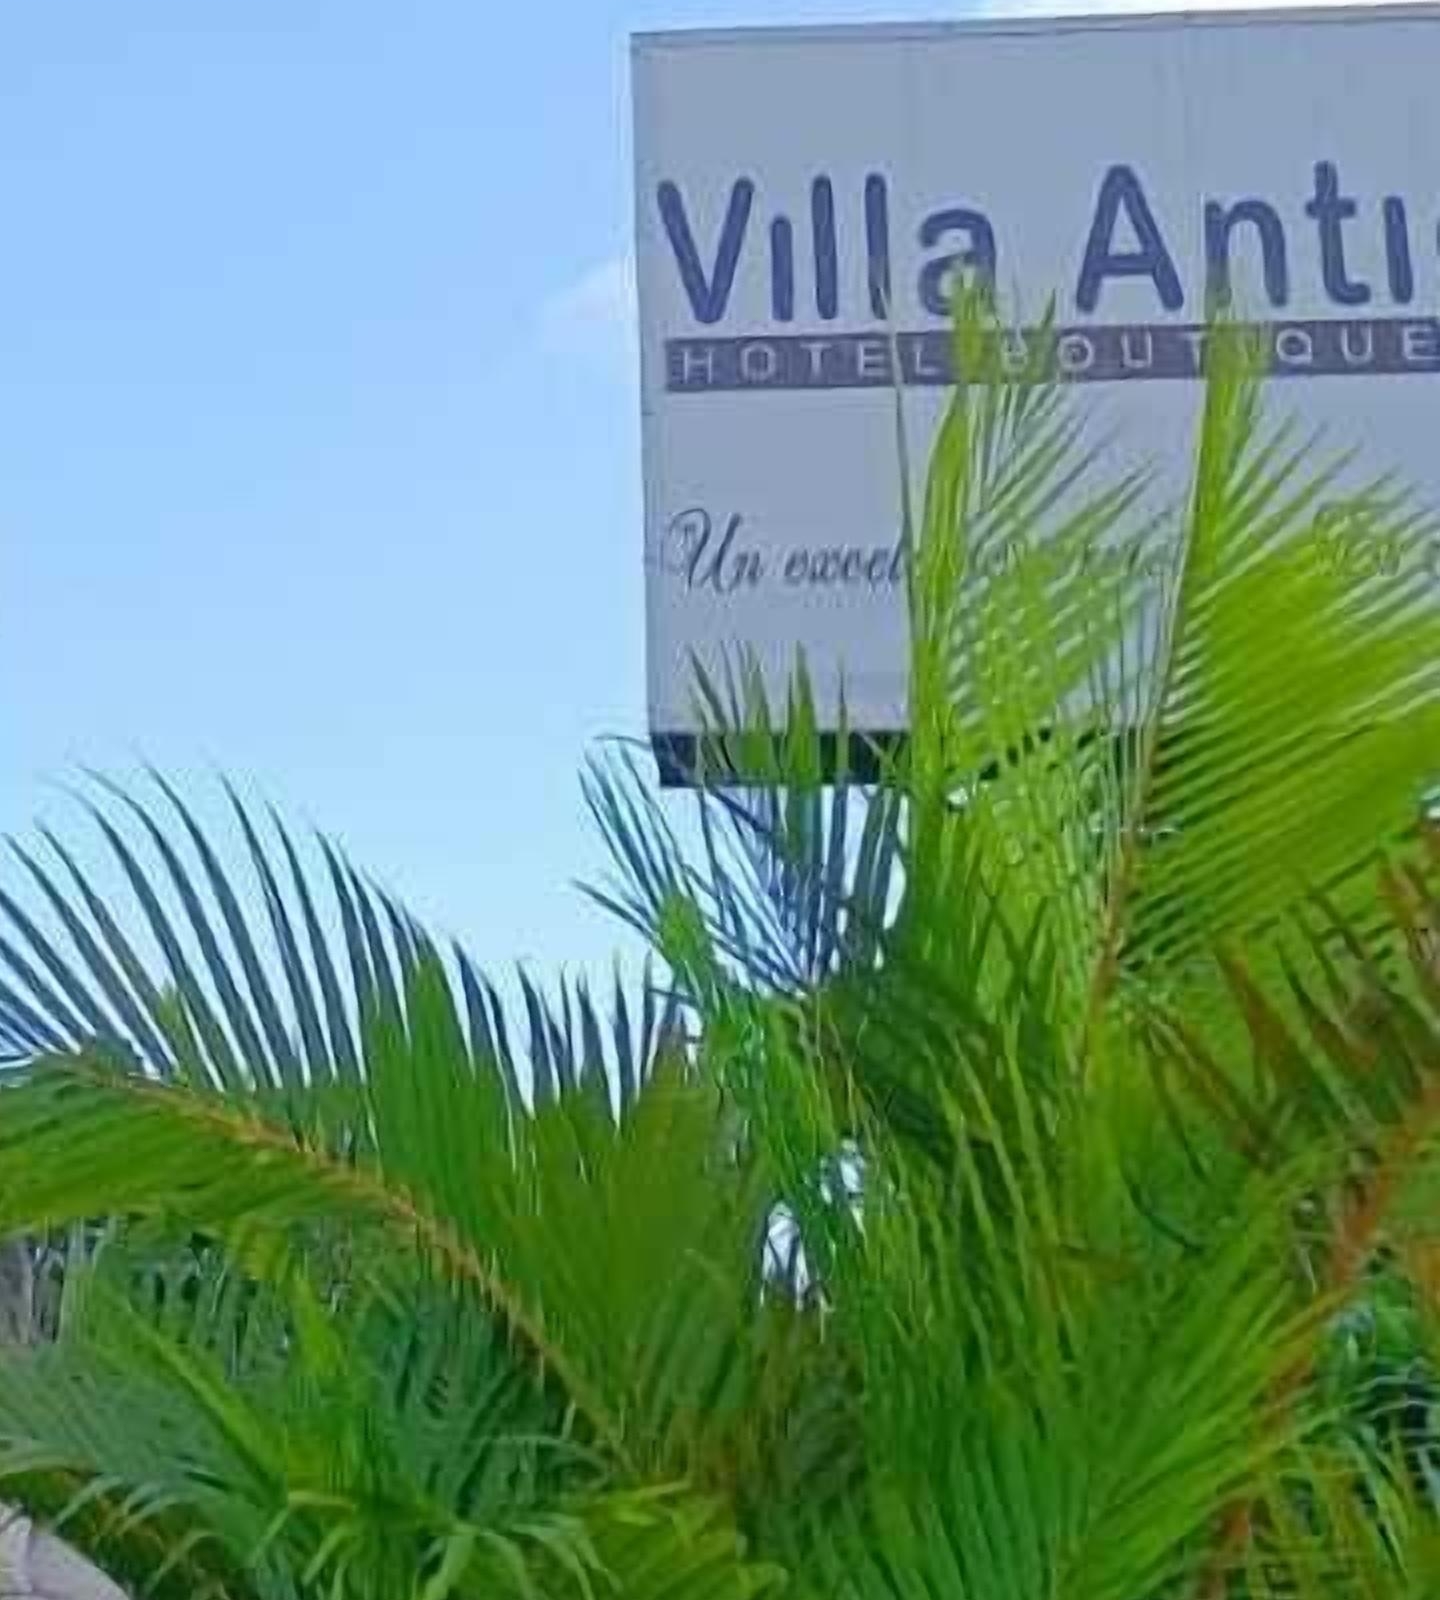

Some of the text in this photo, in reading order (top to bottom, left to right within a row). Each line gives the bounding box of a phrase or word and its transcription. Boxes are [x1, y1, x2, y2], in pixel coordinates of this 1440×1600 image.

[656, 159, 1440, 324] Villa Anti
[681, 324, 1440, 384] HOTEL BOUTQUE
[668, 507, 761, 593] Un
